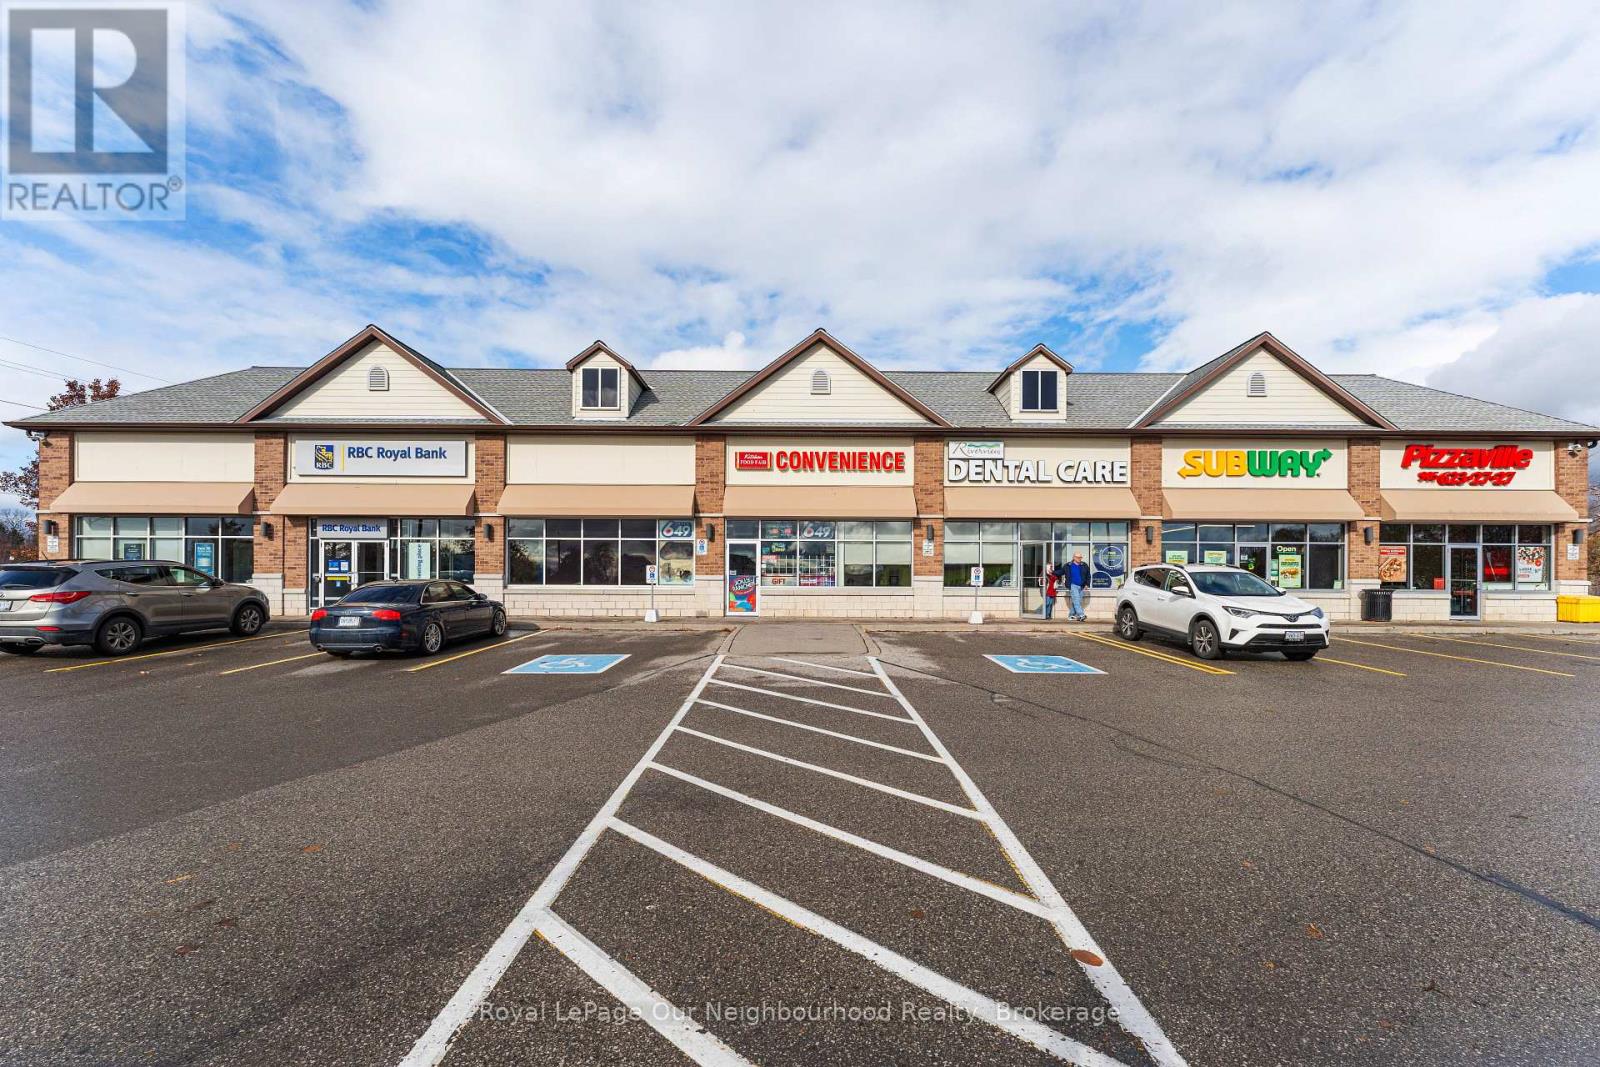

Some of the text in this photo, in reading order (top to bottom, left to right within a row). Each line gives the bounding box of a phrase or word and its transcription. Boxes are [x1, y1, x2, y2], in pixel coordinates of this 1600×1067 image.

[347, 446, 447, 462] RBC Royal Bank
[775, 450, 906, 473] CONVENIENCE
[1177, 448, 1334, 479] SUBWAY
[1401, 444, 1534, 470] Pizzaville
[316, 461, 332, 469] RBC
[948, 459, 1128, 483] DENTAL CARE
[322, 524, 381, 534] RBC Royal Bank
[1276, 545, 1297, 553] Open
